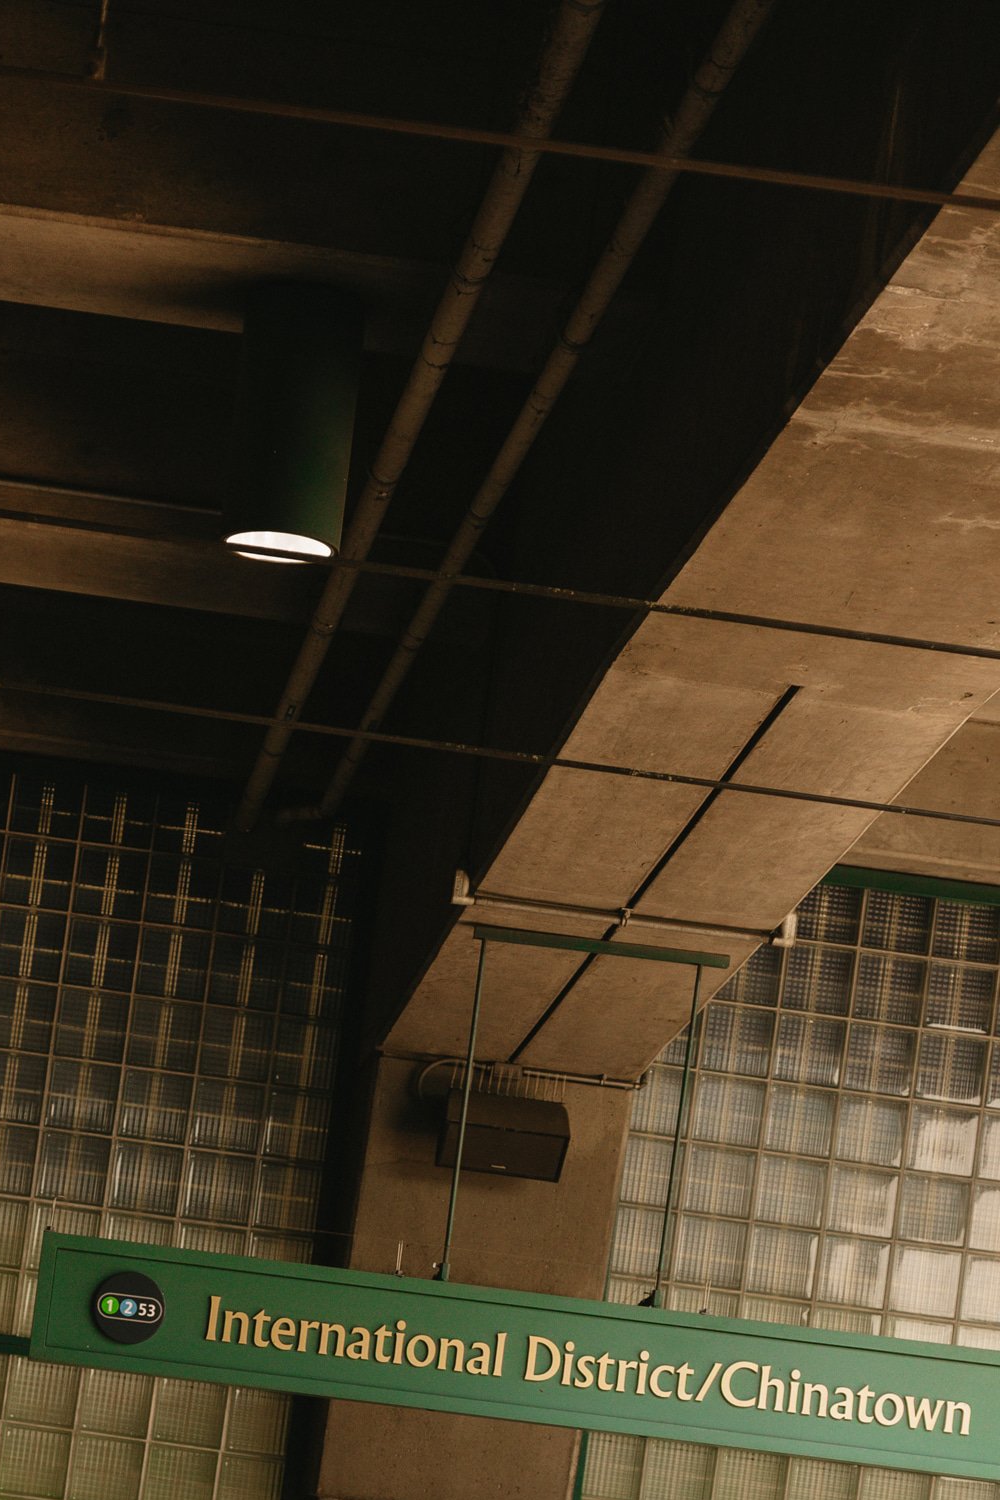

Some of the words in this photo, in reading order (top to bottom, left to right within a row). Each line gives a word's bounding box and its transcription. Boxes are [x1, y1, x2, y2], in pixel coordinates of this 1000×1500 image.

[106, 1299, 114, 1312] 1
[124, 1301, 133, 1314] 2
[138, 1303, 156, 1317] 53
[205, 1295, 508, 1377] International
[524, 1335, 973, 1437] District/Chinatown
